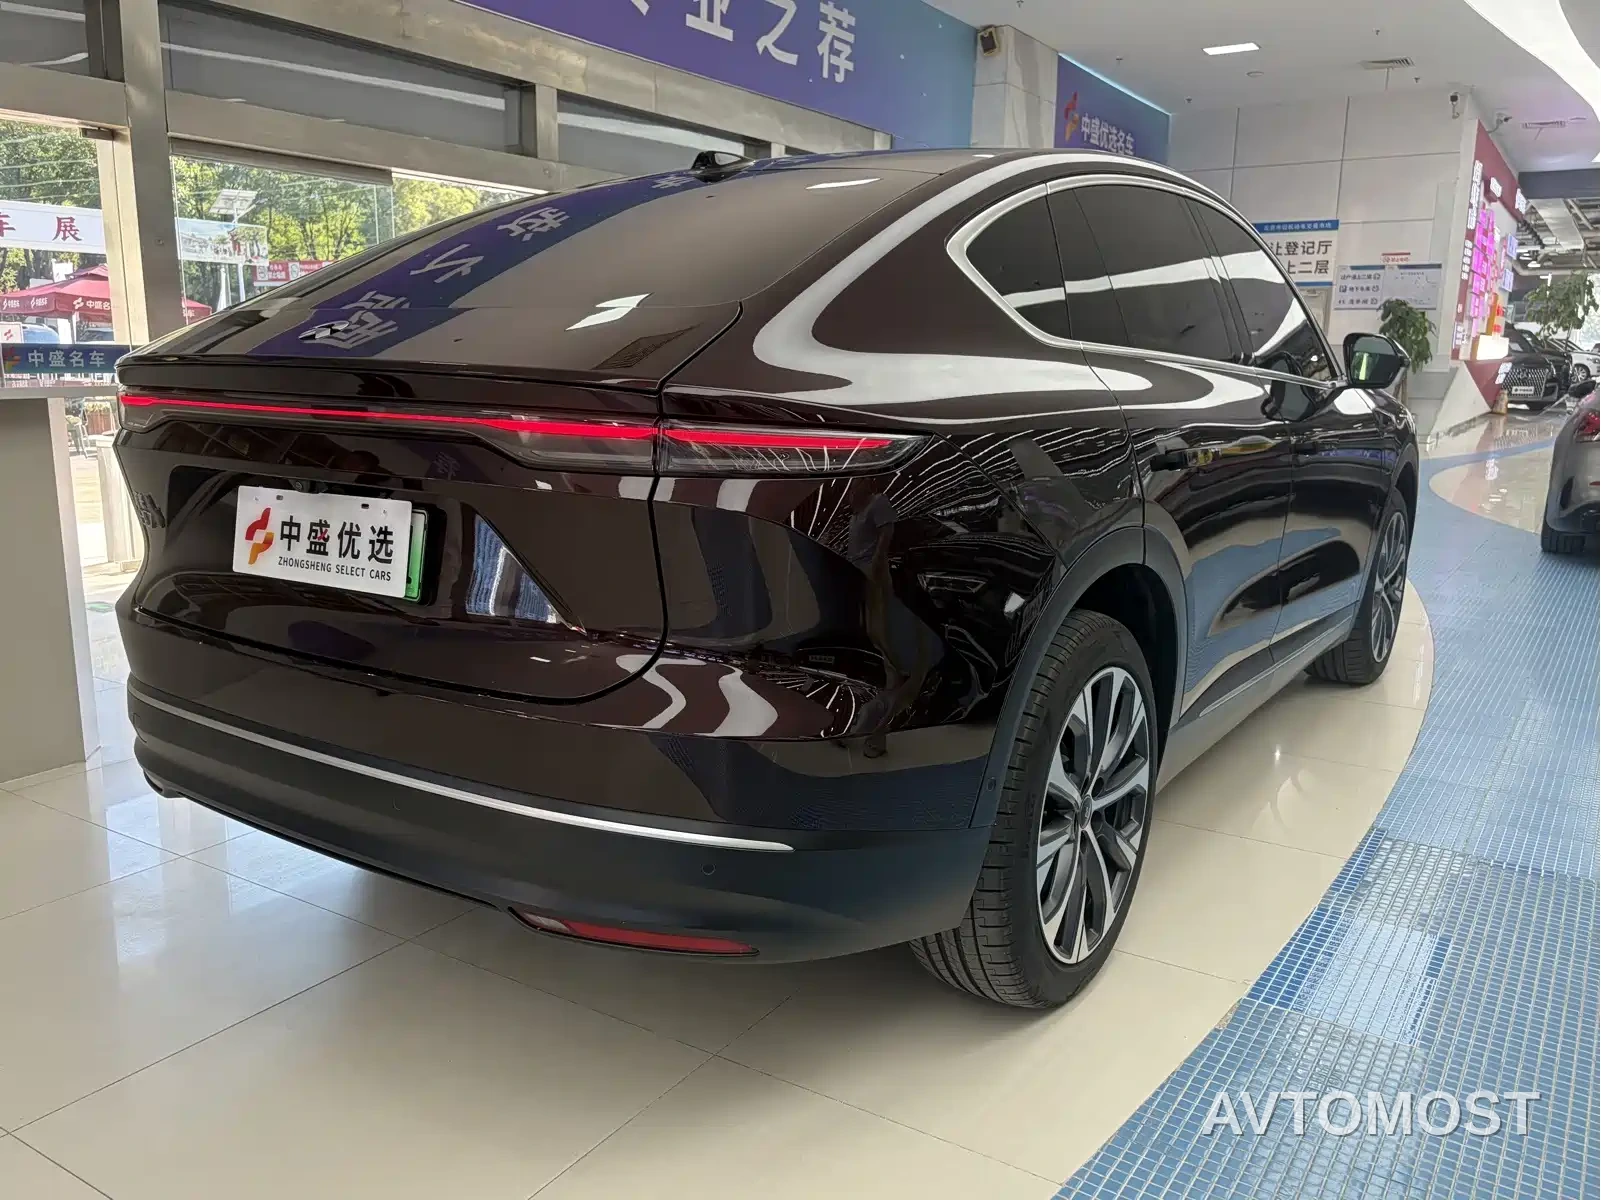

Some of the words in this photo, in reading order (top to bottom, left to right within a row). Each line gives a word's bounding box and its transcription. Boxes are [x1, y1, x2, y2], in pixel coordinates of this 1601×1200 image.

[1081, 112, 1134, 155] 中盛优选名车
[28, 349, 106, 368] 中盛名车
[279, 515, 395, 565] 中盛优选
[278, 556, 332, 574] ZHONGSHENG
[335, 564, 366, 578] SELECT
[369, 568, 392, 582] CARS
